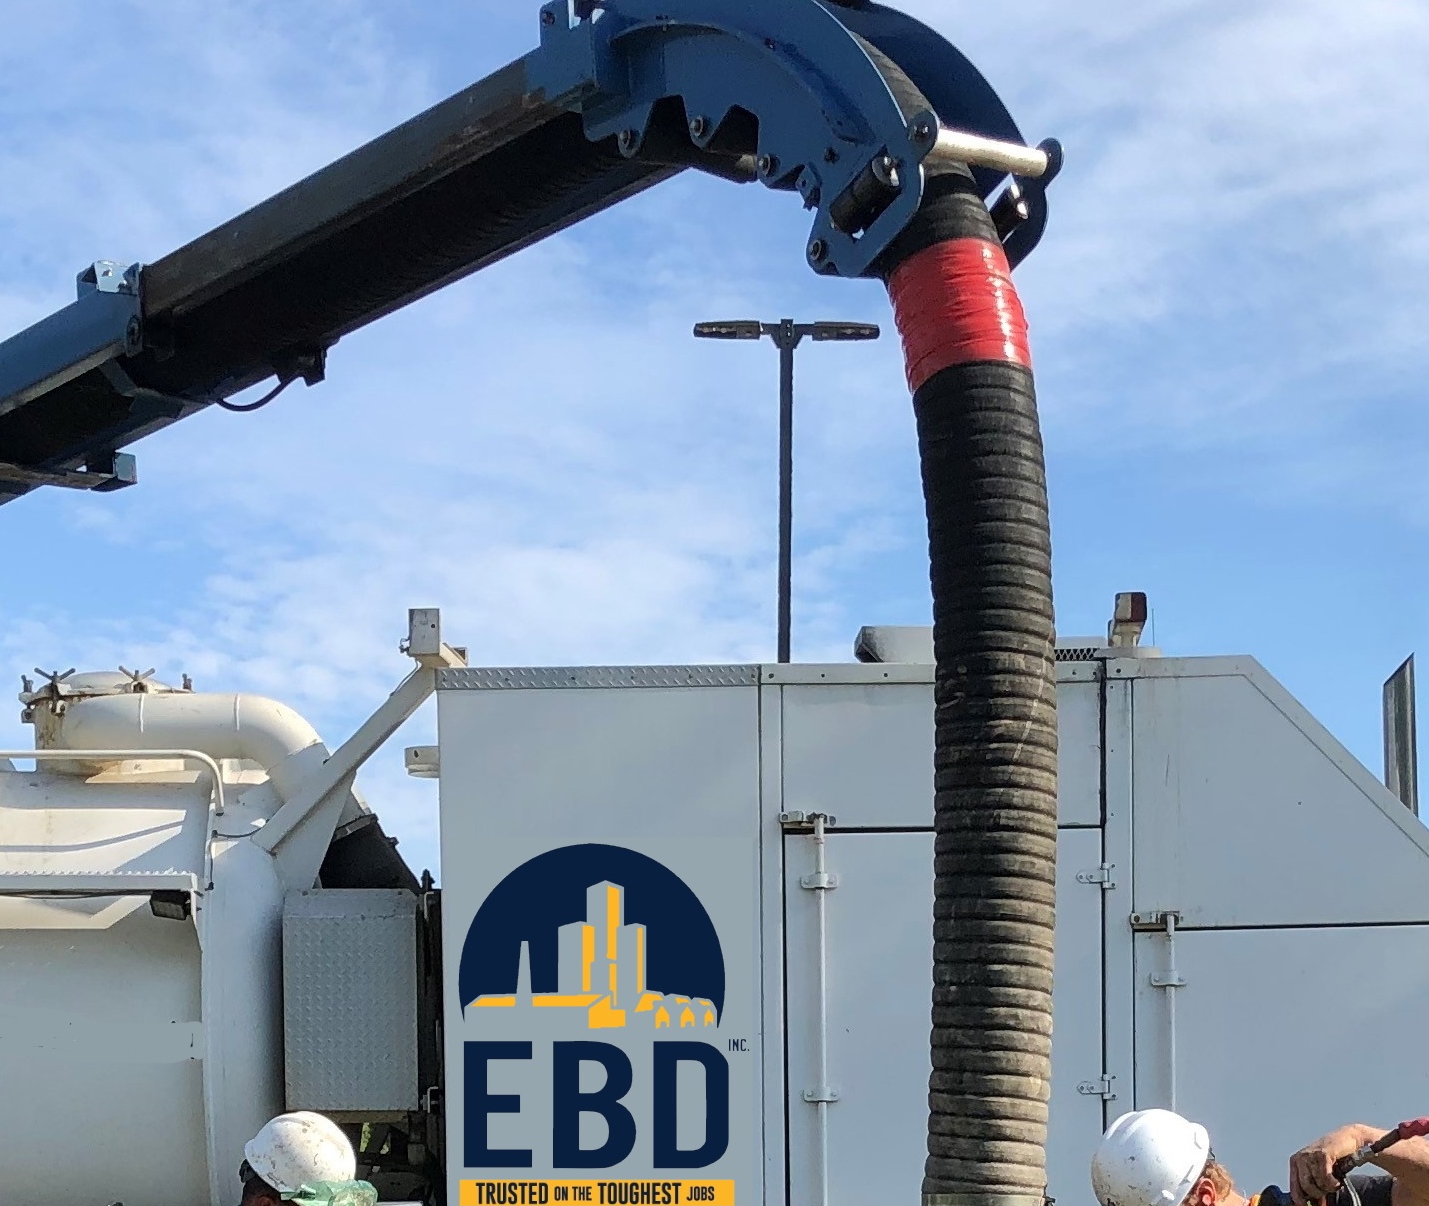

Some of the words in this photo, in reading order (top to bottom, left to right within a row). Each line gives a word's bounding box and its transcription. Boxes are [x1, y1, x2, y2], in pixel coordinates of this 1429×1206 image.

[728, 1038, 750, 1052] INC.
[463, 1040, 730, 1169] EBD
[475, 1182, 549, 1205] TRUSTED
[554, 1186, 569, 1202] ON
[572, 1186, 592, 1202] THE
[597, 1182, 682, 1205] TOUGHEST
[686, 1186, 715, 1202] JOBS
